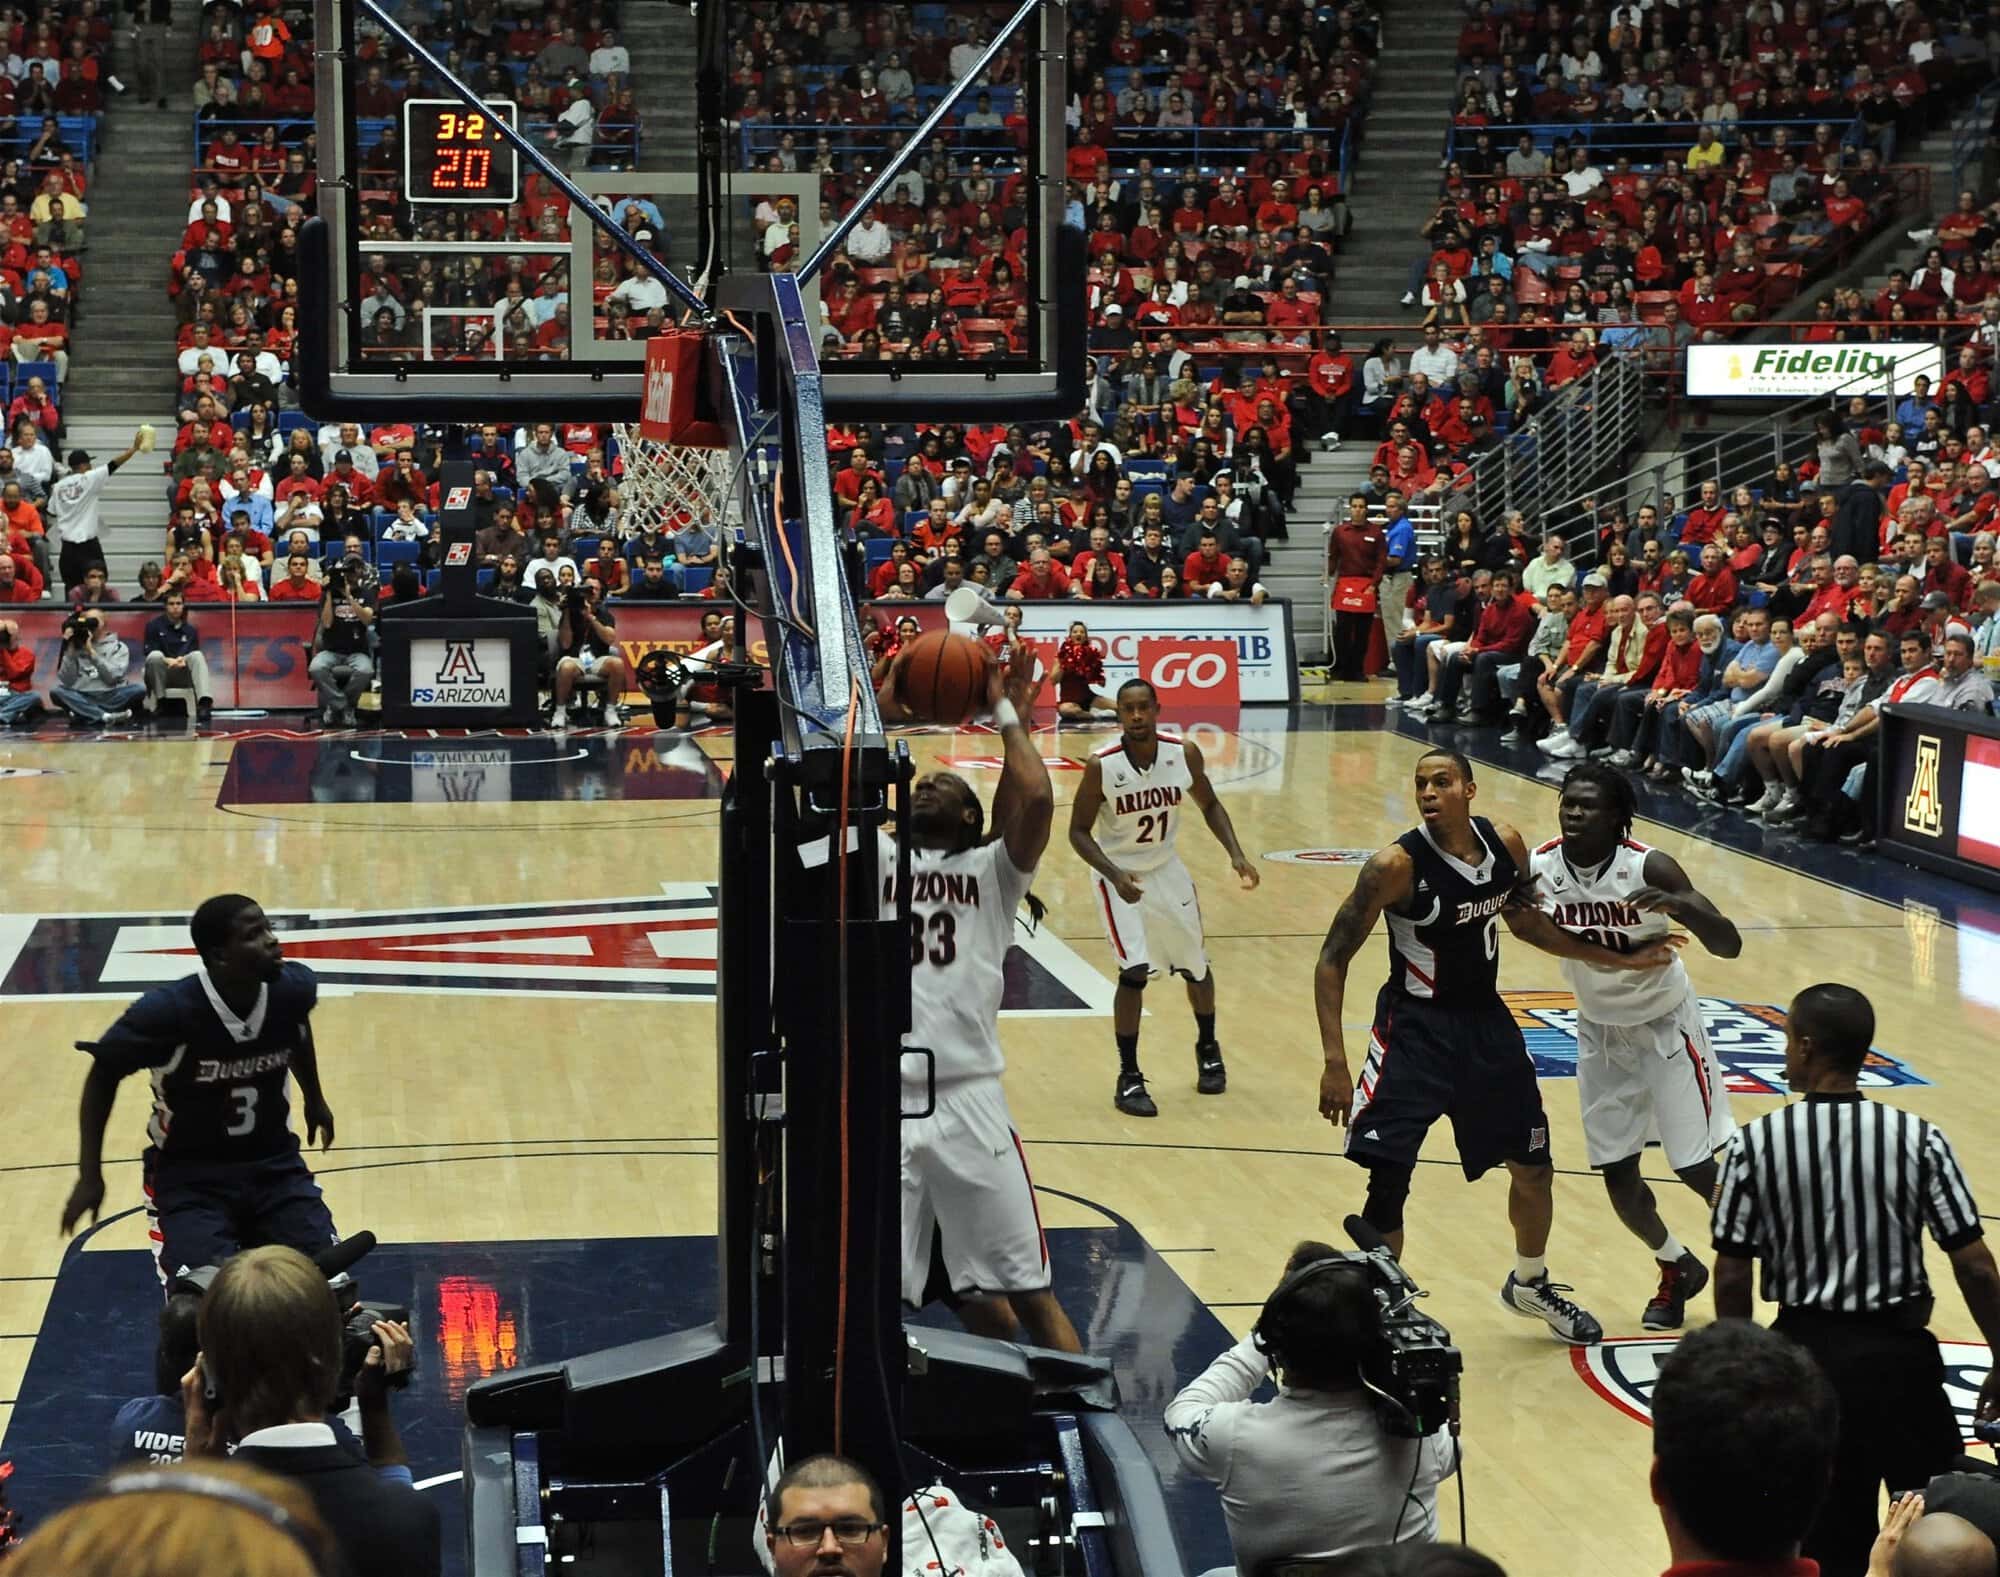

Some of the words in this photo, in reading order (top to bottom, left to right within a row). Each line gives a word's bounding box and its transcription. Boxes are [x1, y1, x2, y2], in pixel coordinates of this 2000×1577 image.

[436, 113, 503, 141] 3:2
[432, 149, 492, 188] 20
[1753, 349, 1897, 380] Fidelity
[436, 639, 485, 684] A
[1151, 652, 1227, 689] GO
[1115, 786, 1183, 816] ARIZONA
[1904, 734, 1942, 838] A
[1135, 811, 1169, 844] 21
[1553, 900, 1643, 927] ARIZONA
[1483, 912, 1499, 961] 0
[226, 1086, 259, 1137] 3
[134, 1430, 187, 1453] VIDE
